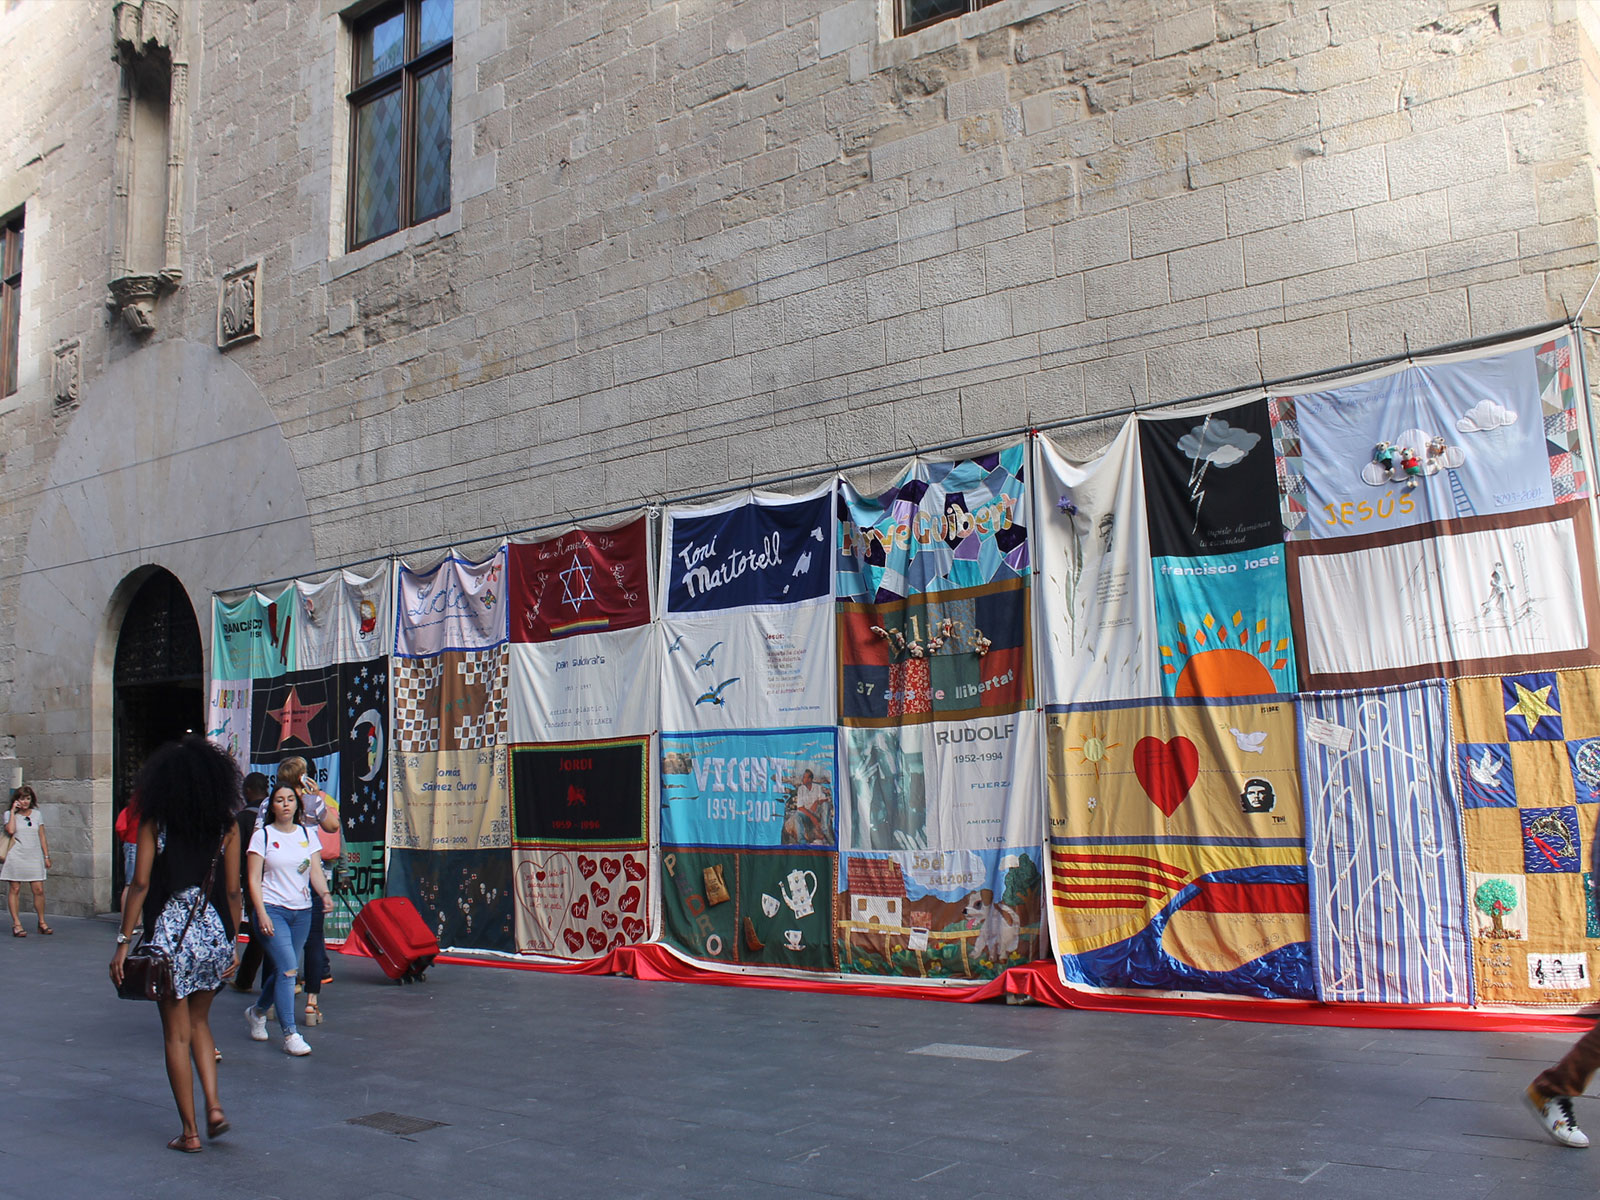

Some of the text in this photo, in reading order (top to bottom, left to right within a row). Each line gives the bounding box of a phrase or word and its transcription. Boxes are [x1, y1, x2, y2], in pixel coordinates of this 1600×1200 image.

[913, 493, 1017, 546] Guibert
[1323, 490, 1416, 526] JESÚS
[679, 535, 718, 571] Toni
[682, 531, 783, 598] Martorell
[1161, 562, 1238, 577] francisco
[856, 681, 875, 696] 37
[955, 668, 1014, 699] llibertat
[936, 724, 1015, 746] RUDOLF
[560, 758, 593, 771] JORDI
[953, 751, 1003, 764] 1952-1994
[456, 781, 478, 791] Curto
[692, 756, 787, 794] VICENT
[912, 851, 944, 871] Joel
